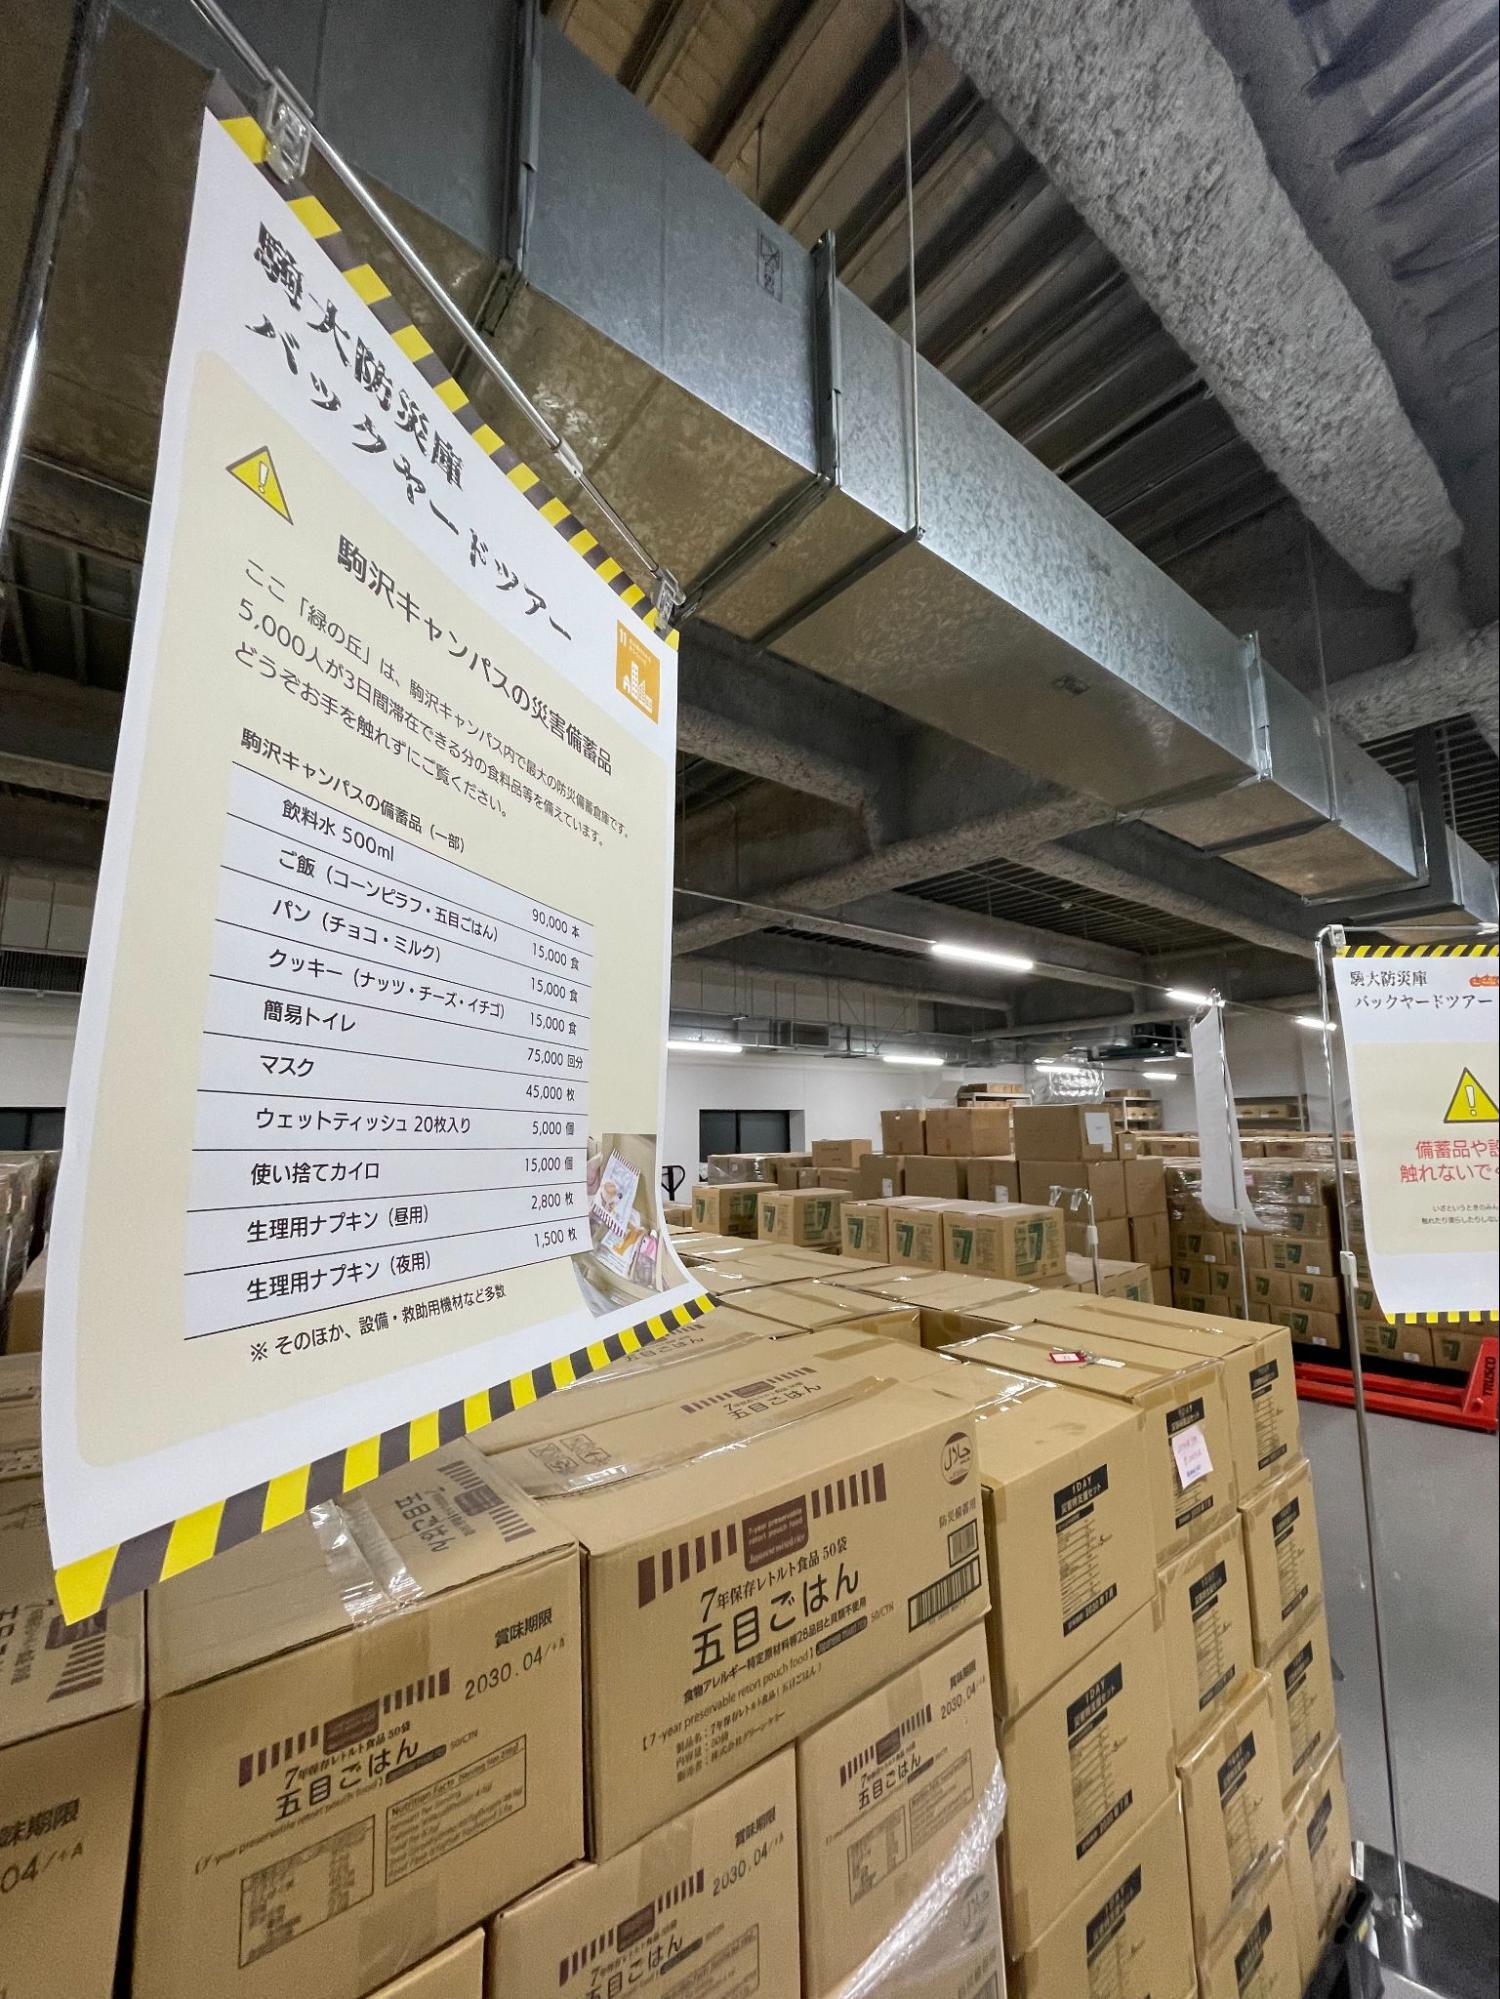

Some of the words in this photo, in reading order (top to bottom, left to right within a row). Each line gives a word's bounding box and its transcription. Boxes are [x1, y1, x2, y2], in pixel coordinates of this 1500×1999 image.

[254, 222, 463, 491] 駒大防災庫
[245, 314, 572, 640] バックヤードツアー
[337, 534, 613, 776] 駒沢キャンパスの災害備蓄品
[235, 642, 507, 818] どうぞお手を触れずにご覧ください。
[240, 727, 465, 853] 駒沢キャンパスの備蓄品（一部）
[282, 799, 336, 836] 飲料水
[342, 827, 394, 861] 500ml
[532, 908, 568, 935] 90,000
[571, 925, 581, 939] 本
[279, 849, 498, 942] ご飯（コーンピラフ・五目ごはん）
[532, 942, 567, 967] 15,000
[570, 956, 580, 971] 食
[272, 899, 441, 963] パン（チョコ・ミルク）
[530, 977, 566, 1001] 15,000
[569, 988, 579, 1004] 食
[269, 948, 505, 1018] クッキー（ナッツ・チーズ・イチゴ）
[529, 1012, 565, 1034] 15,000
[568, 1021, 577, 1036] 食
[1355, 994, 1493, 1009] バックヤードツアー
[263, 999, 356, 1032] 簡易トイレ
[527, 1047, 563, 1068] 75,000
[567, 1055, 584, 1069] 回分
[260, 1055, 315, 1077] マスク
[525, 1084, 563, 1102] 45,000
[566, 1087, 576, 1102] 枚
[256, 1107, 408, 1132] ウェットティッシュ
[414, 1115, 472, 1134] 20枚入り
[532, 1121, 562, 1137] 5,000
[565, 1122, 575, 1136] 個
[250, 1161, 380, 1186] 使い捨てカイロ
[524, 1157, 560, 1173] 15,000
[564, 1157, 574, 1171] 個
[1400, 1164, 1499, 1182] 触れないで
[246, 1204, 429, 1243] 生理用ナプキン（昼用）
[531, 1193, 561, 1211] 2,800
[564, 1191, 574, 1206] 枚
[246, 1250, 431, 1302] 生理用ナプキン（夜用）
[534, 1229, 564, 1248] 1,500
[567, 1226, 577, 1242] 枚
[1482, 1356, 1497, 1397] TRUSCO
[692, 1563, 859, 1675] 五目ごはん
[700, 1550, 820, 1624] 7年保存レトルト食品
[822, 1536, 848, 1560] 50袋
[495, 1608, 552, 1648] 賞味期限
[763, 1661, 789, 1688] pouch
[275, 1738, 419, 1821] 五目ごはん
[859, 1753, 921, 1811] 五目ごはん
